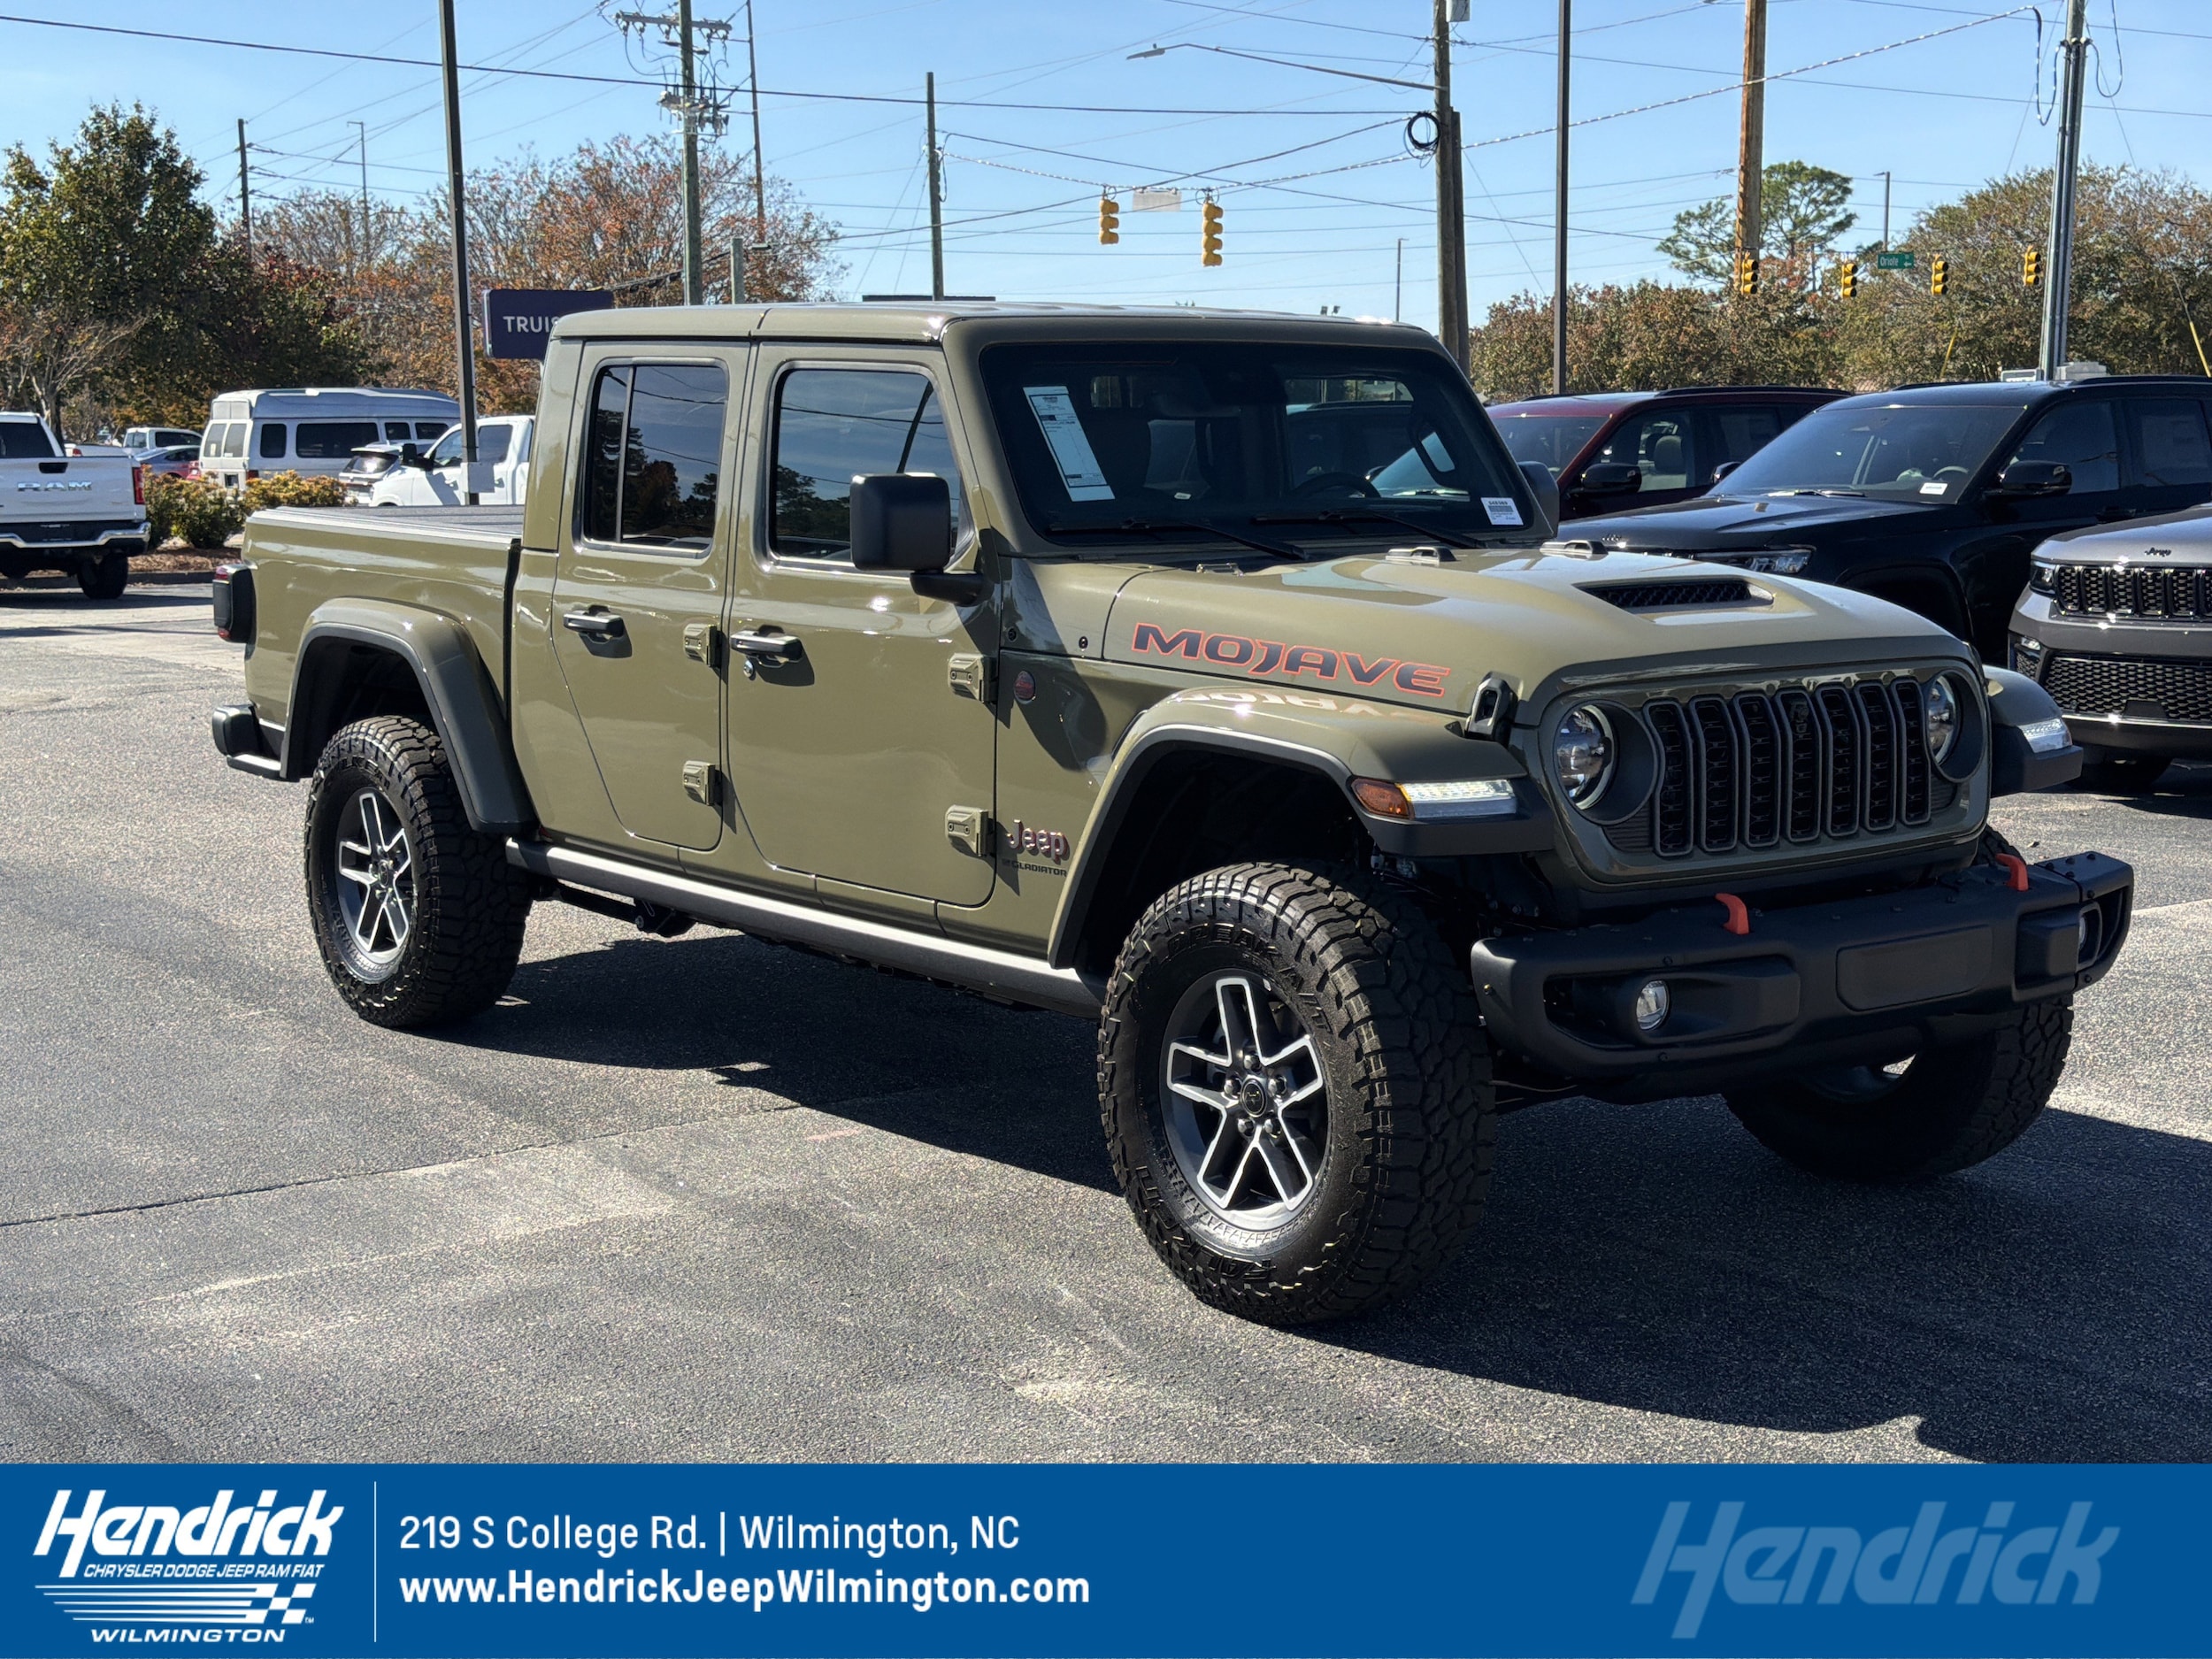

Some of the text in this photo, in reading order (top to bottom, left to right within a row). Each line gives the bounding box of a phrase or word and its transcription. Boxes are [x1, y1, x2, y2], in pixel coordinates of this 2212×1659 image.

[17, 481, 92, 492] RAM
[1132, 622, 1451, 698] MOJAVE
[1006, 818, 1069, 861] Jeep
[1010, 860, 1068, 877] GLADIATOR
